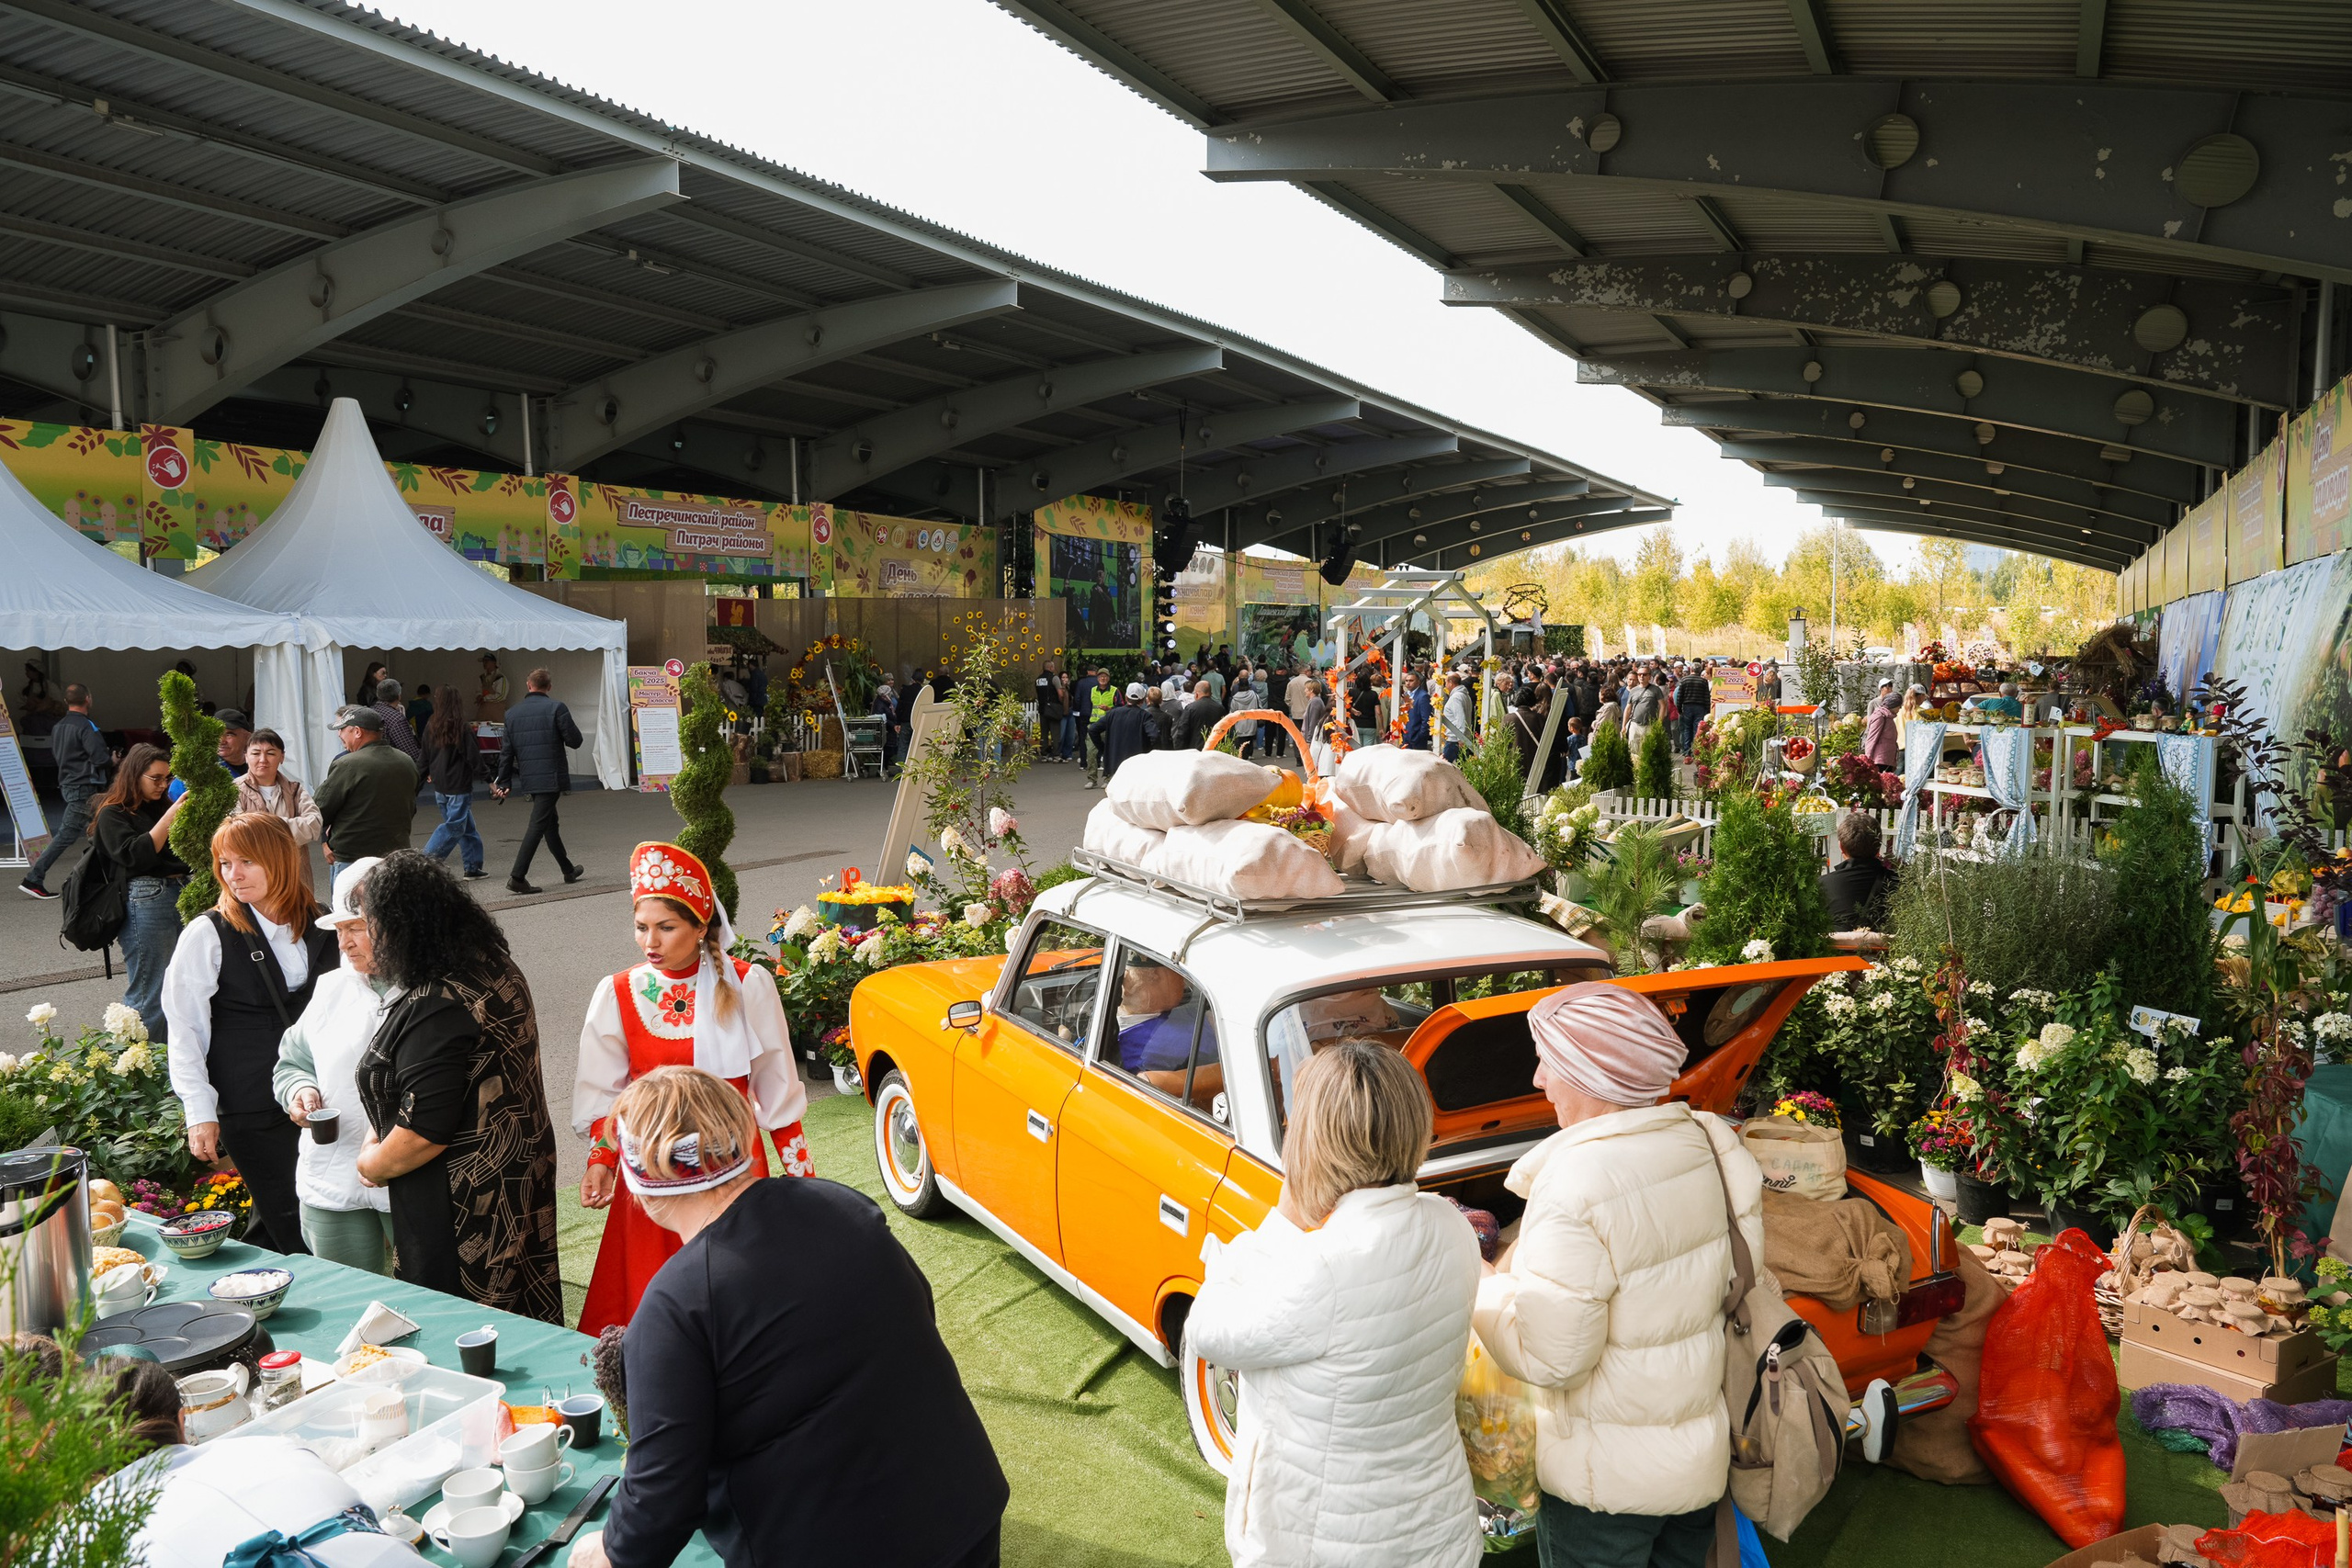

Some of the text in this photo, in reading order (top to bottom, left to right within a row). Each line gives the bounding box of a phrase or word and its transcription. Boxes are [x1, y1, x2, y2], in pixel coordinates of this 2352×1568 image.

[2312, 422, 2330, 474] День
[628, 502, 756, 530] Пестречинский район
[675, 530, 765, 551] Питрәч районы
[885, 561, 919, 585] День
